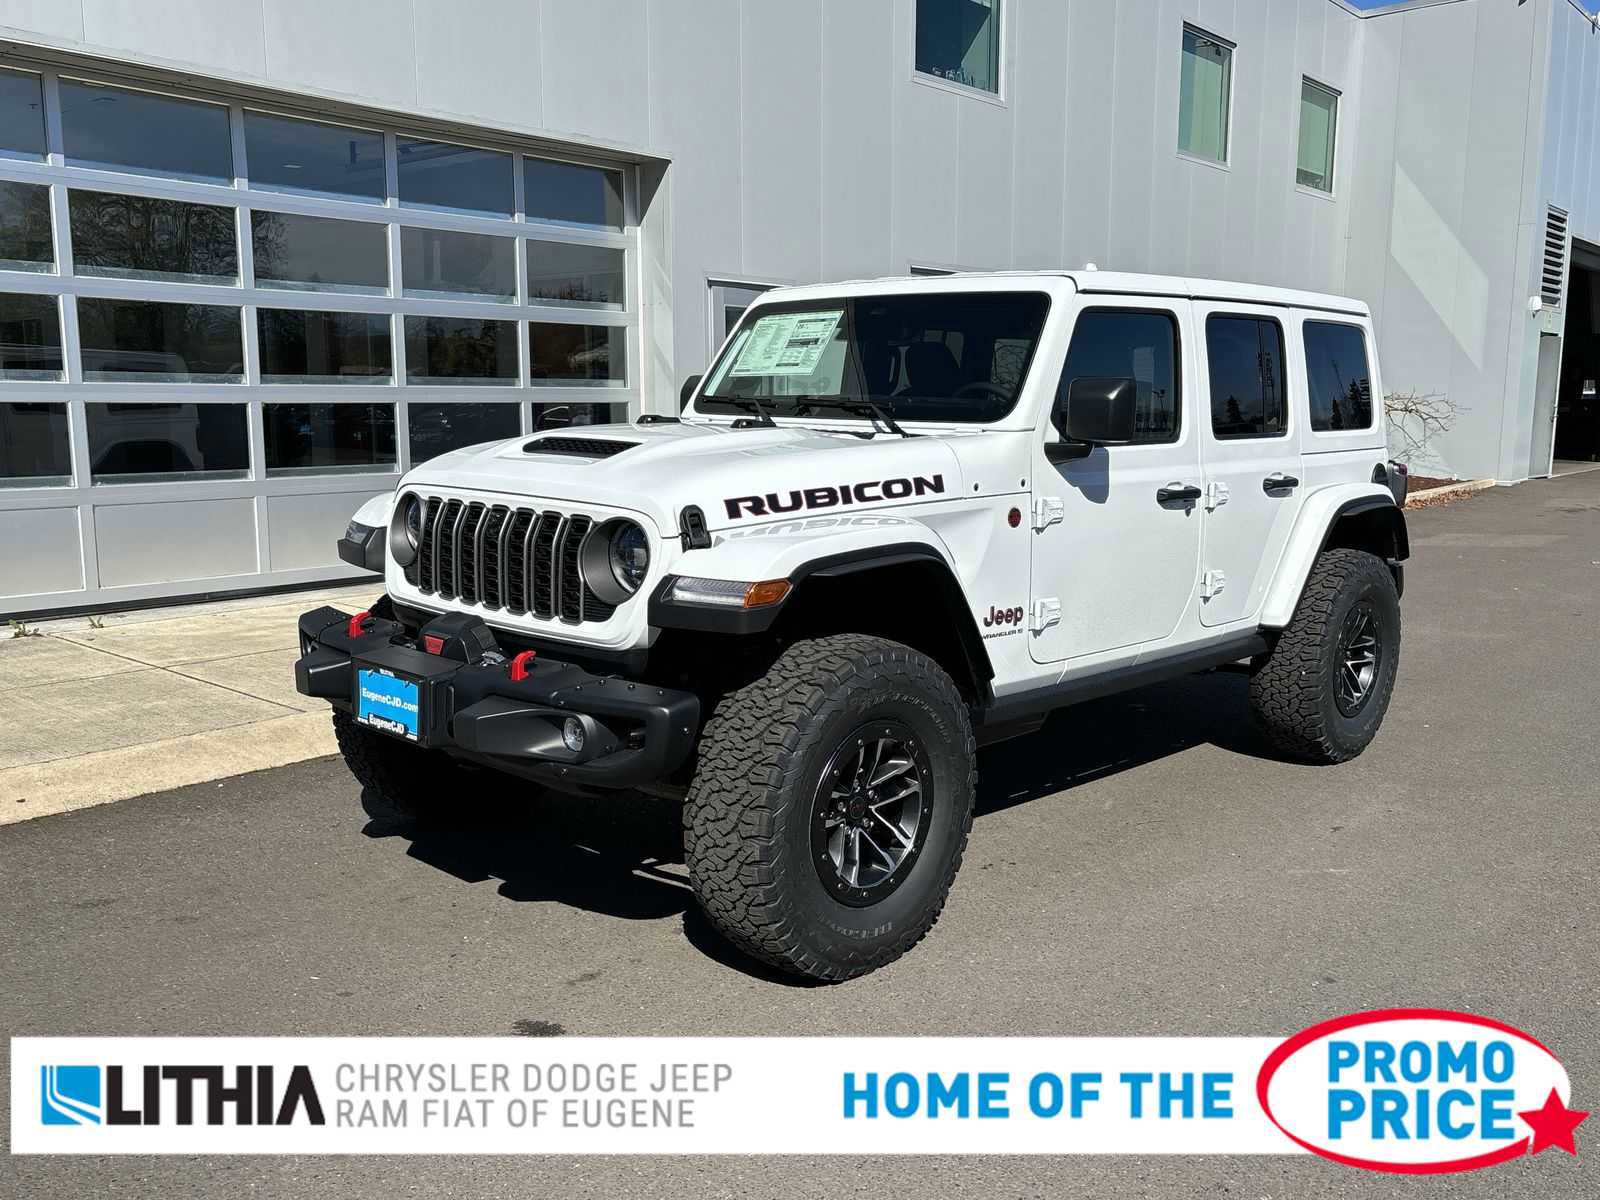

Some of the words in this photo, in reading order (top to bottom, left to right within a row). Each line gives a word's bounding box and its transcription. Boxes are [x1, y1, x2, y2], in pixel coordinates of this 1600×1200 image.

[724, 474, 945, 519] RUBICON
[983, 606, 1024, 627] Jeep
[362, 687, 418, 713] EugeneCJD.com
[369, 713, 405, 735] EugeneCJD
